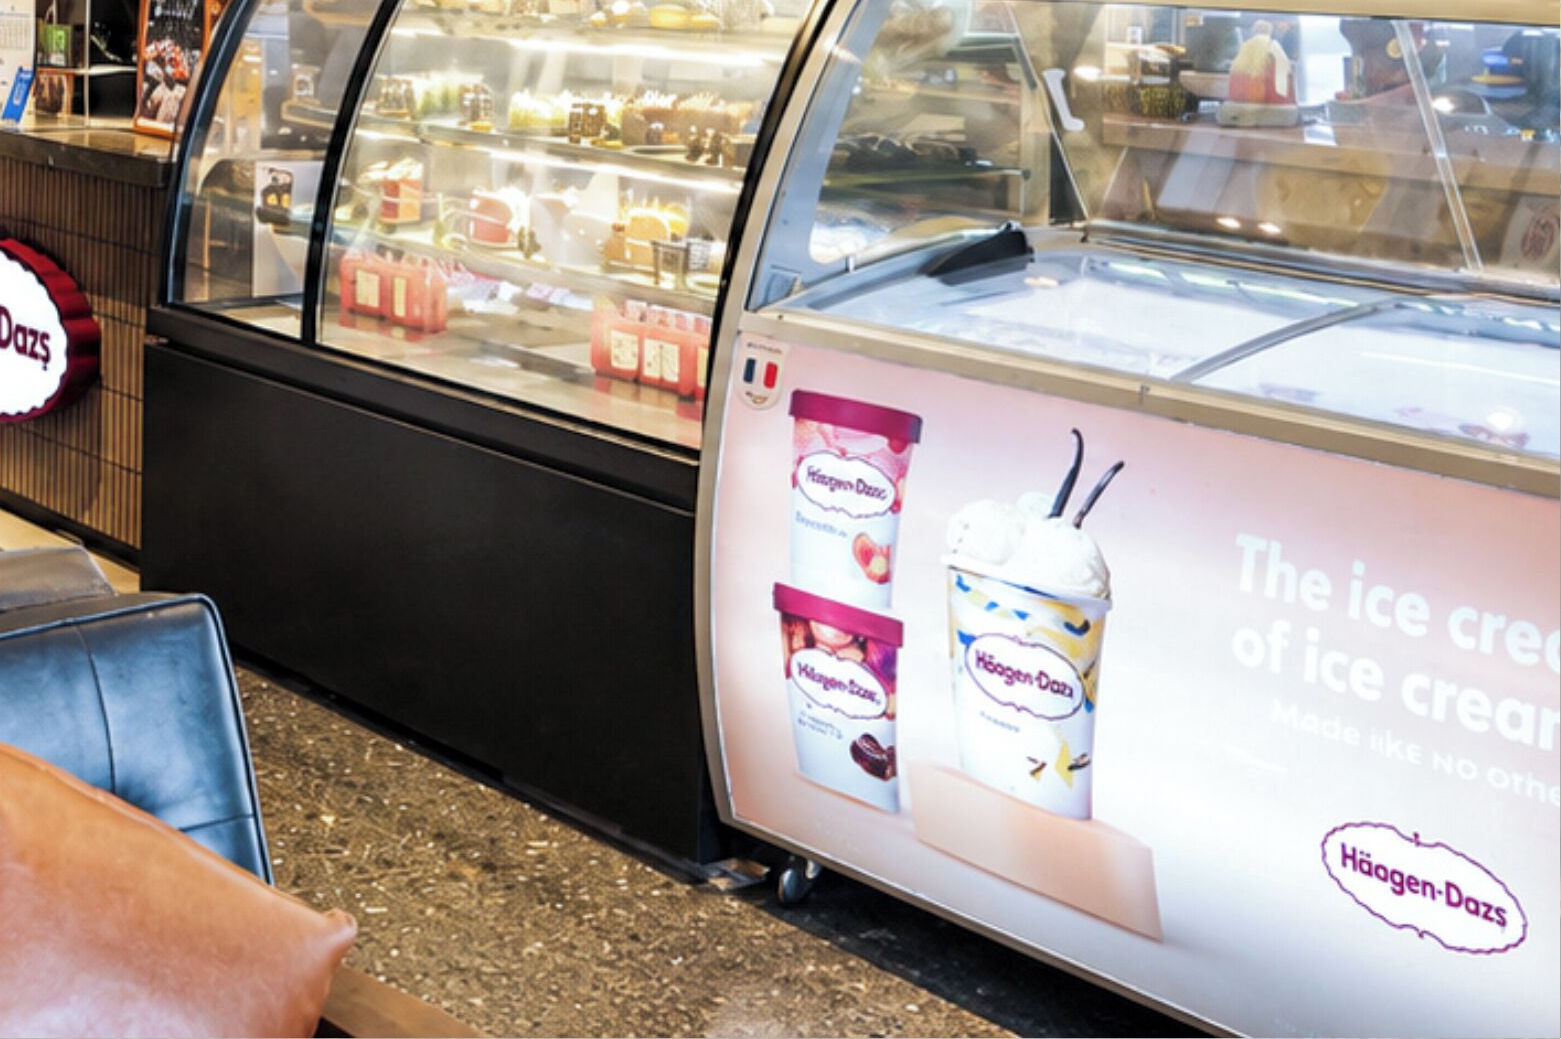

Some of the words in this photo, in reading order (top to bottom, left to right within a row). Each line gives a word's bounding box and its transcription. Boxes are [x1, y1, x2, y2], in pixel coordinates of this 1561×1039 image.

[1235, 531, 1332, 612] The
[1347, 559, 1432, 638] ice
[1231, 618, 1293, 675] of
[1303, 626, 1385, 702] ice
[1270, 698, 1361, 747] Made
[1340, 841, 1508, 929] Häagen-Dazs
